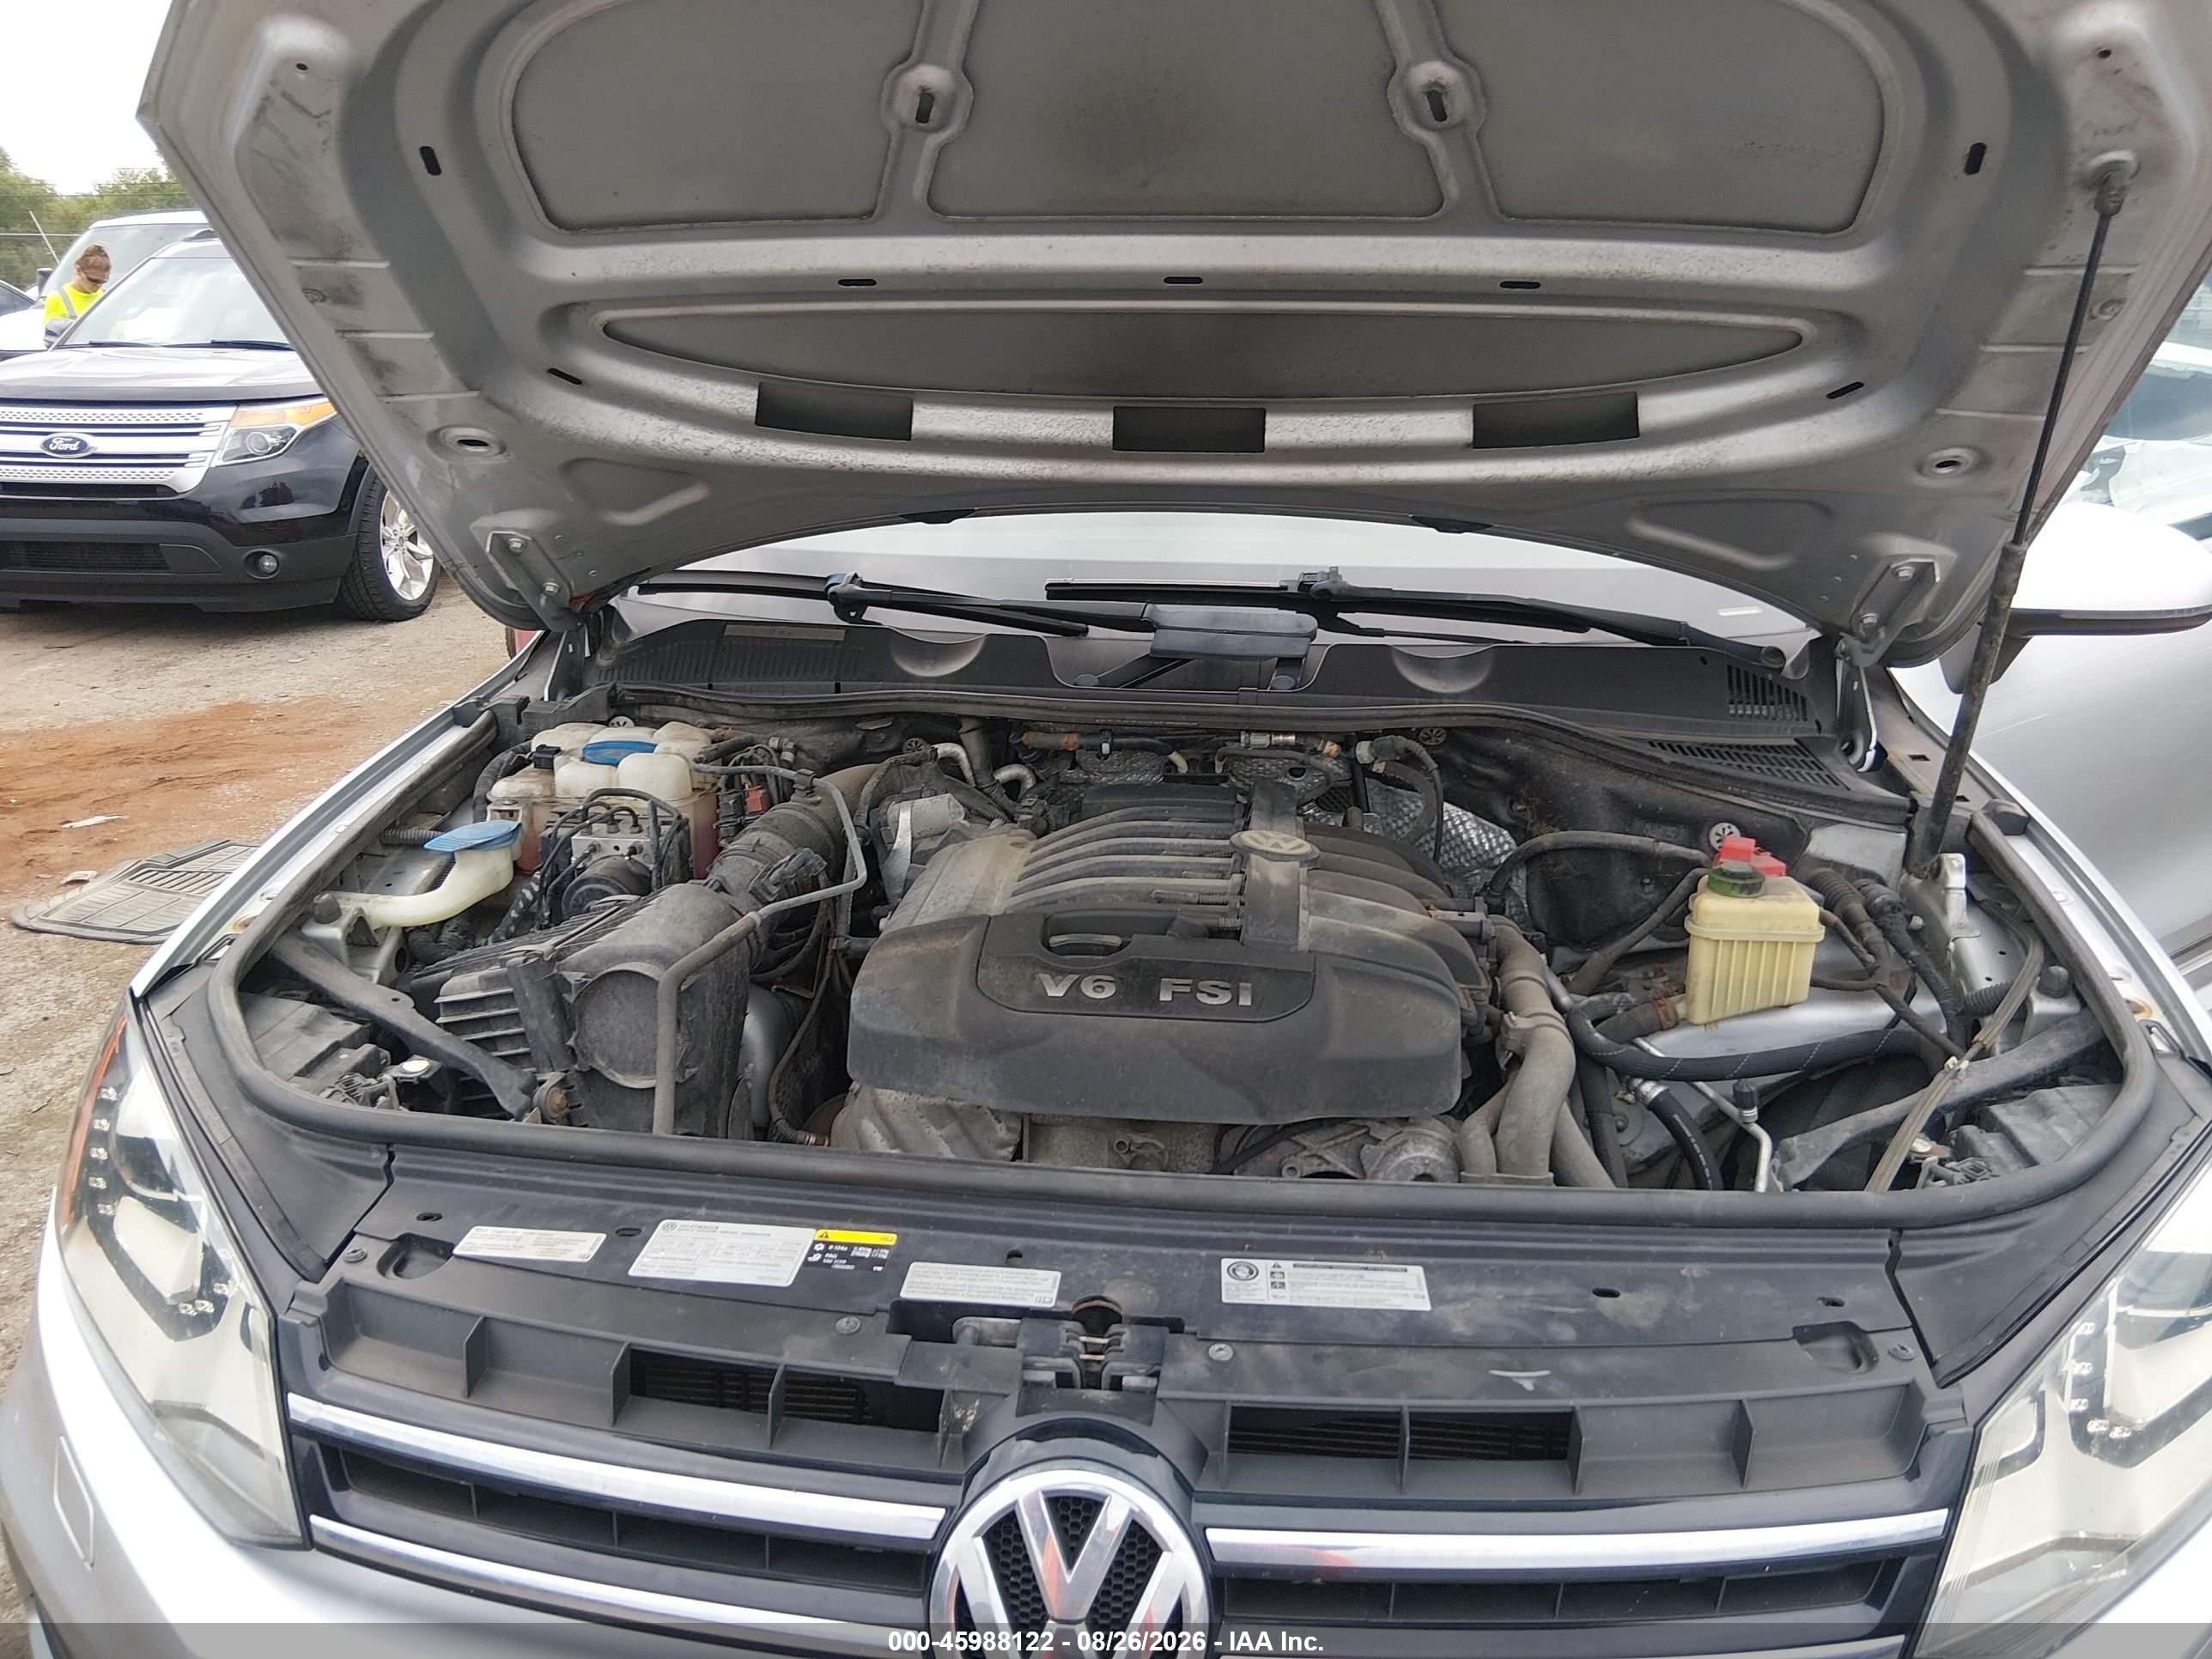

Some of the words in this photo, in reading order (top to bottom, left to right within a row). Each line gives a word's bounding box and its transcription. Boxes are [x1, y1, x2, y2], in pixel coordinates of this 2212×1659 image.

[49, 437, 80, 451] Ford
[1036, 973, 1117, 1000] V6
[1158, 978, 1253, 1006] FSI
